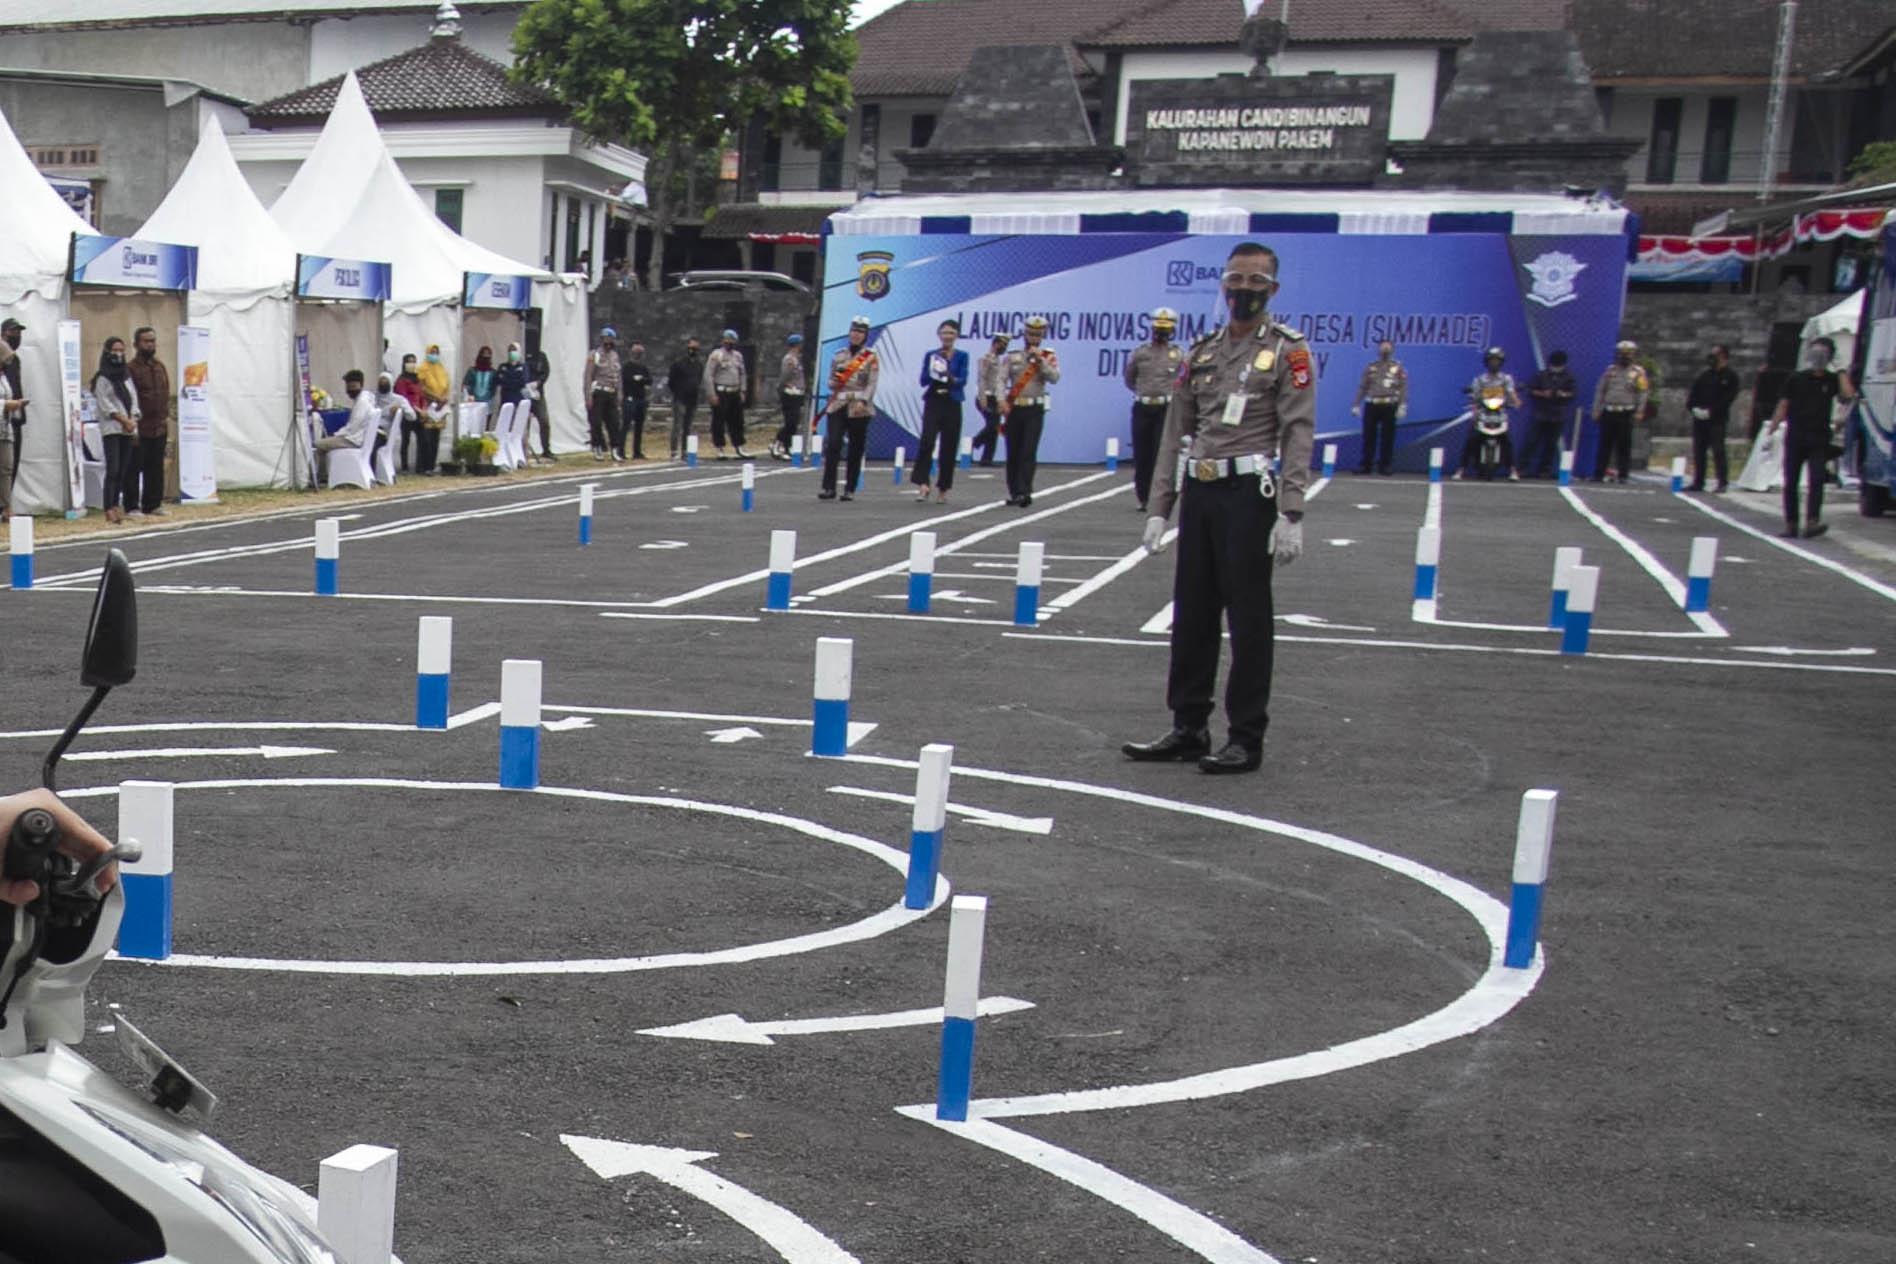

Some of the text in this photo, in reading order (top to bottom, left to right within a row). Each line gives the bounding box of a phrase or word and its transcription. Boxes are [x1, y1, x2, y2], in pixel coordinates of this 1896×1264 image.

[1145, 106, 1371, 129] KALURAHAN CANDIBINANGUN
[1177, 129, 1334, 151] KAPANEWON PAKEM
[958, 311, 1071, 341] LAUNCNG
[1301, 313, 1355, 344] DESA
[1362, 313, 1491, 350] (SIMMADE)
